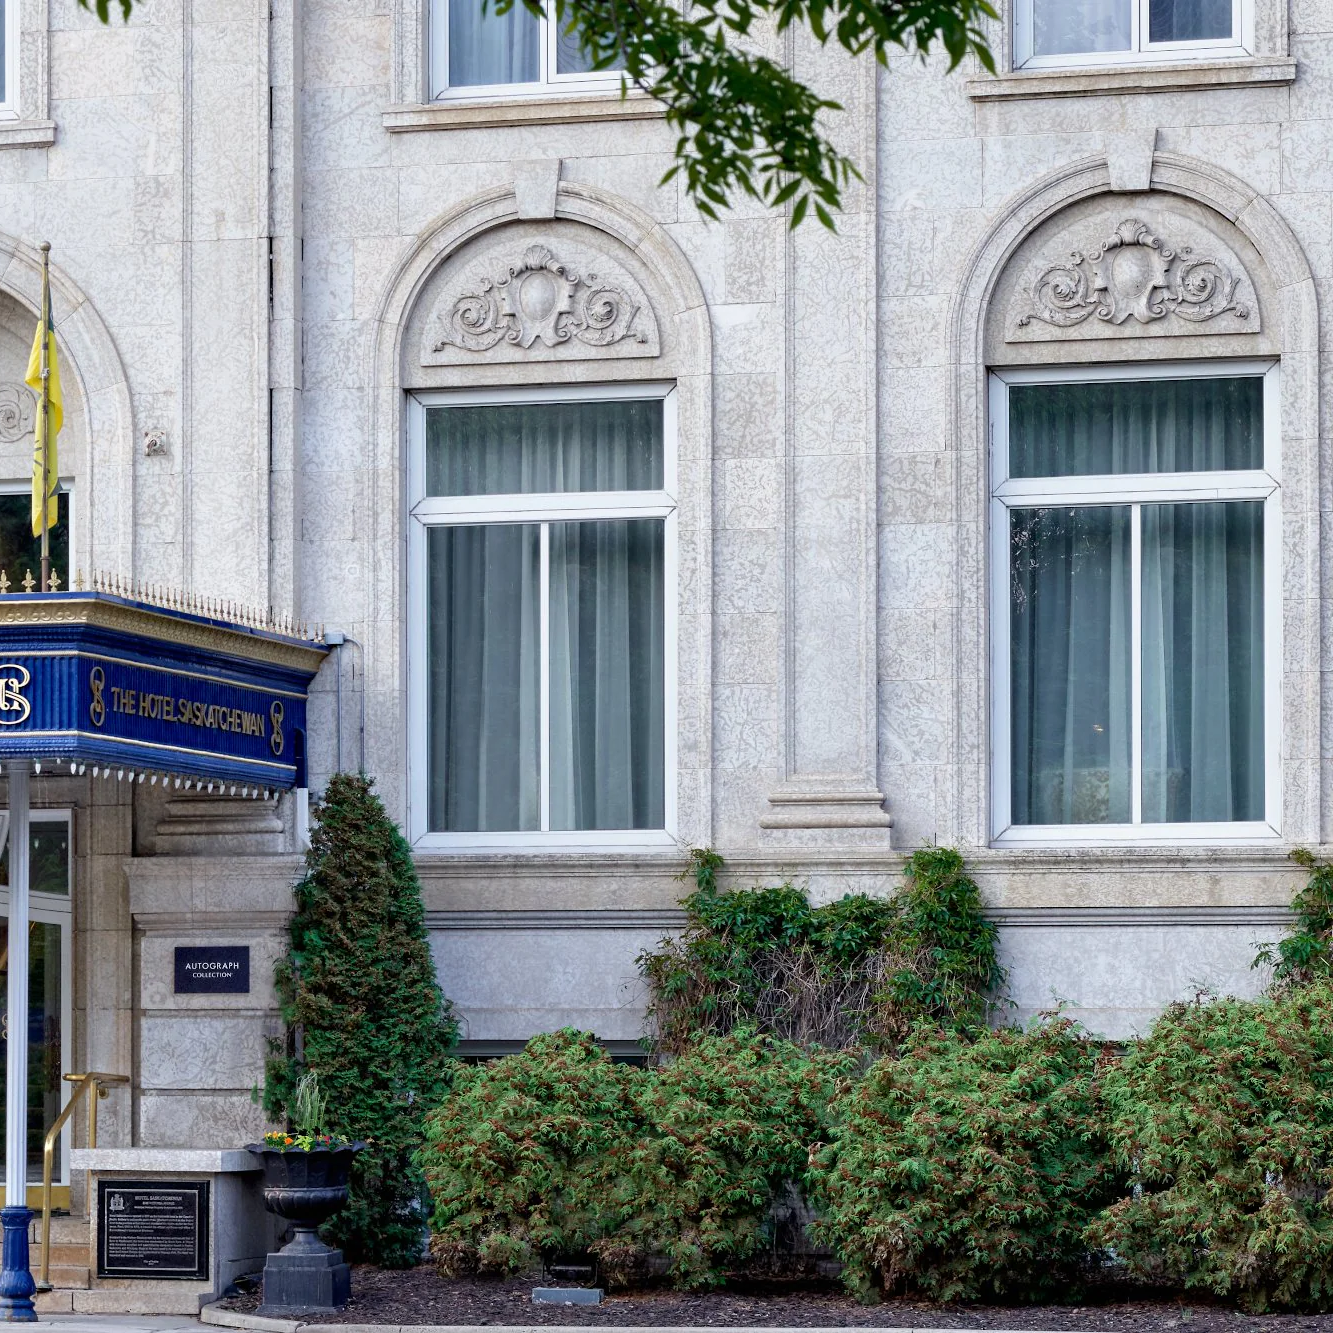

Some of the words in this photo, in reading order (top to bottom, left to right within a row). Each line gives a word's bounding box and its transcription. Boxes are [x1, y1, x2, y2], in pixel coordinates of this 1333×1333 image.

[111, 686, 136, 715] THE
[138, 691, 178, 722] HOTEL
[177, 698, 266, 738] SASKATCHEWAN
[185, 961, 240, 970] AUTOGRAPH
